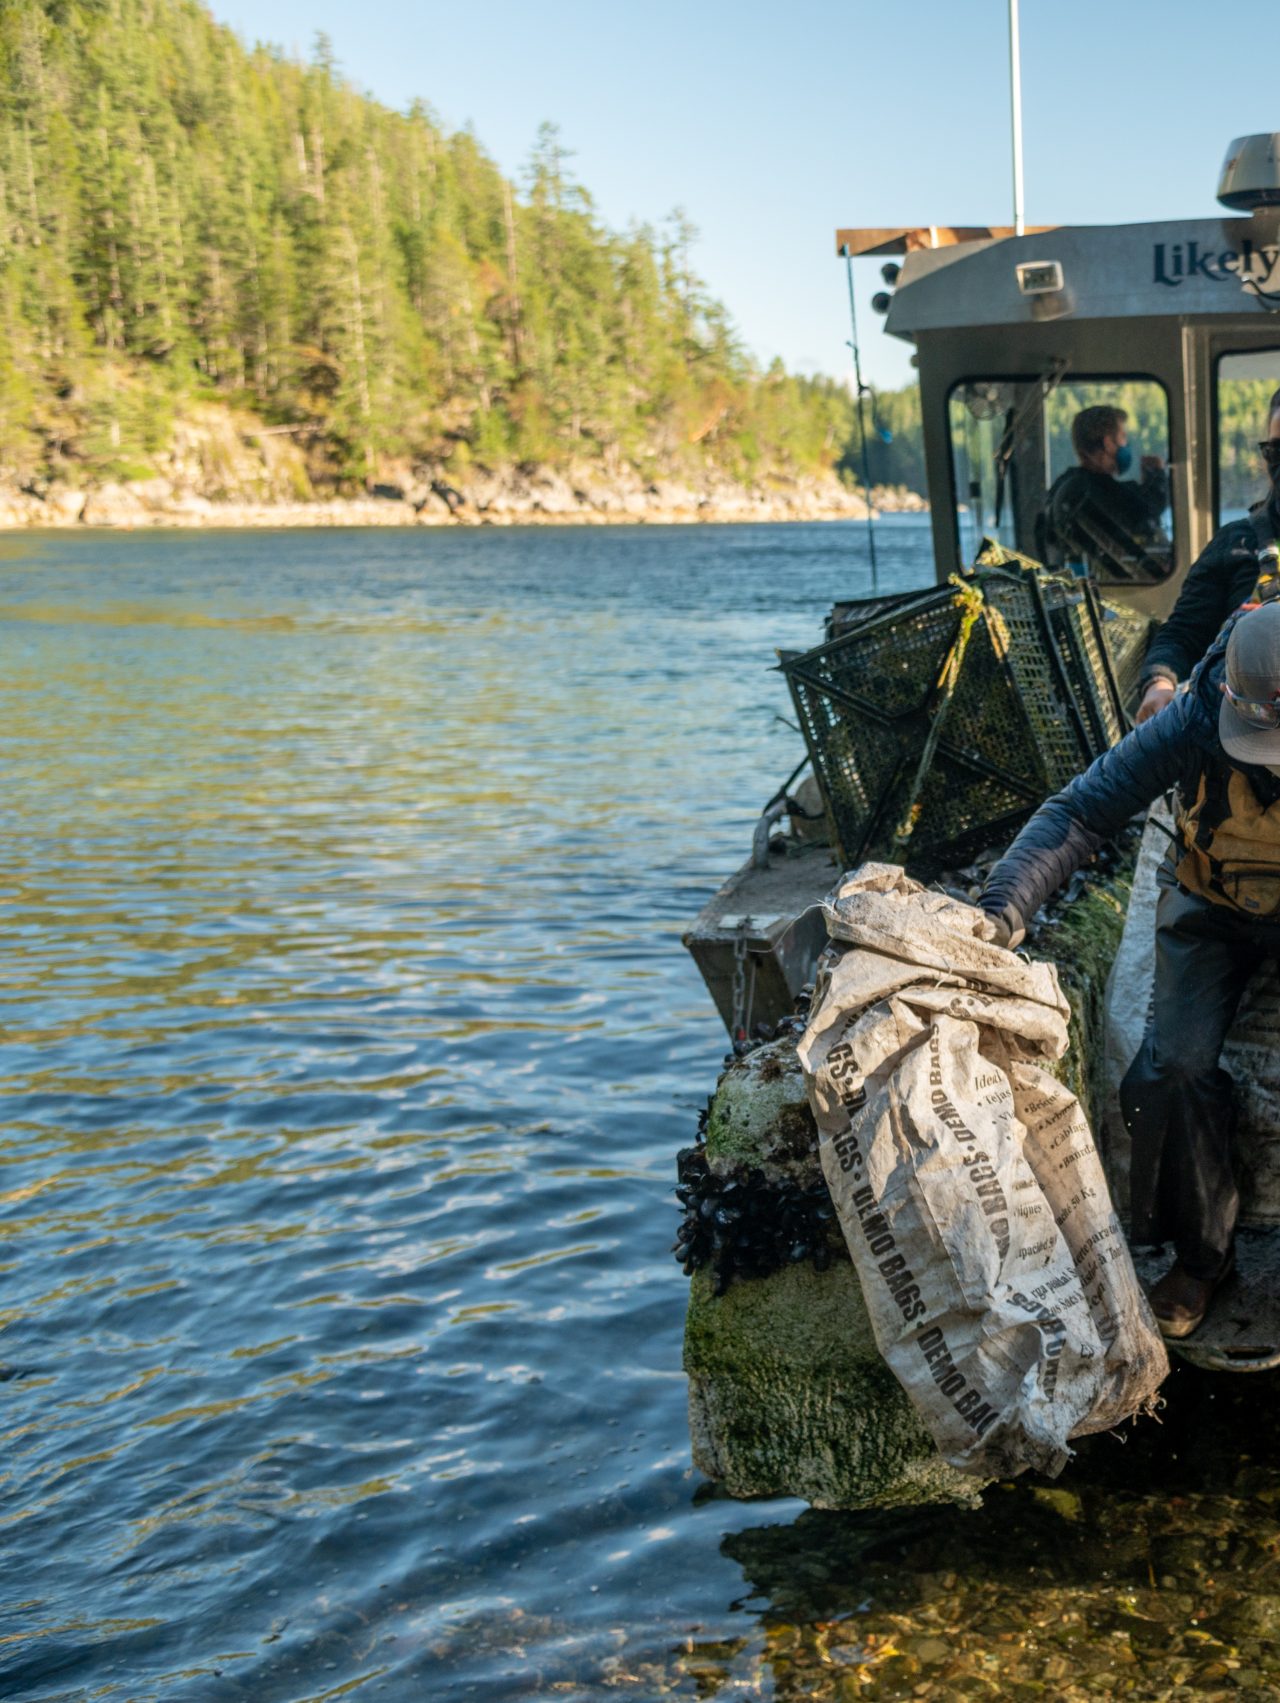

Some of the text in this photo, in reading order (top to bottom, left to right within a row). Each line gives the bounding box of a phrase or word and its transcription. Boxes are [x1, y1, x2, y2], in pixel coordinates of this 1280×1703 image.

[1153, 239, 1280, 284] Likely
[929, 1023, 977, 1142] DEMO BAGS
[974, 1069, 1003, 1092] Ideal
[963, 1151, 1008, 1216] BAGS
[1080, 1185, 1098, 1199] Kg
[852, 1184, 896, 1256] DEMO
[878, 1254, 927, 1322] BAGS
[917, 1326, 967, 1398] DEMO
